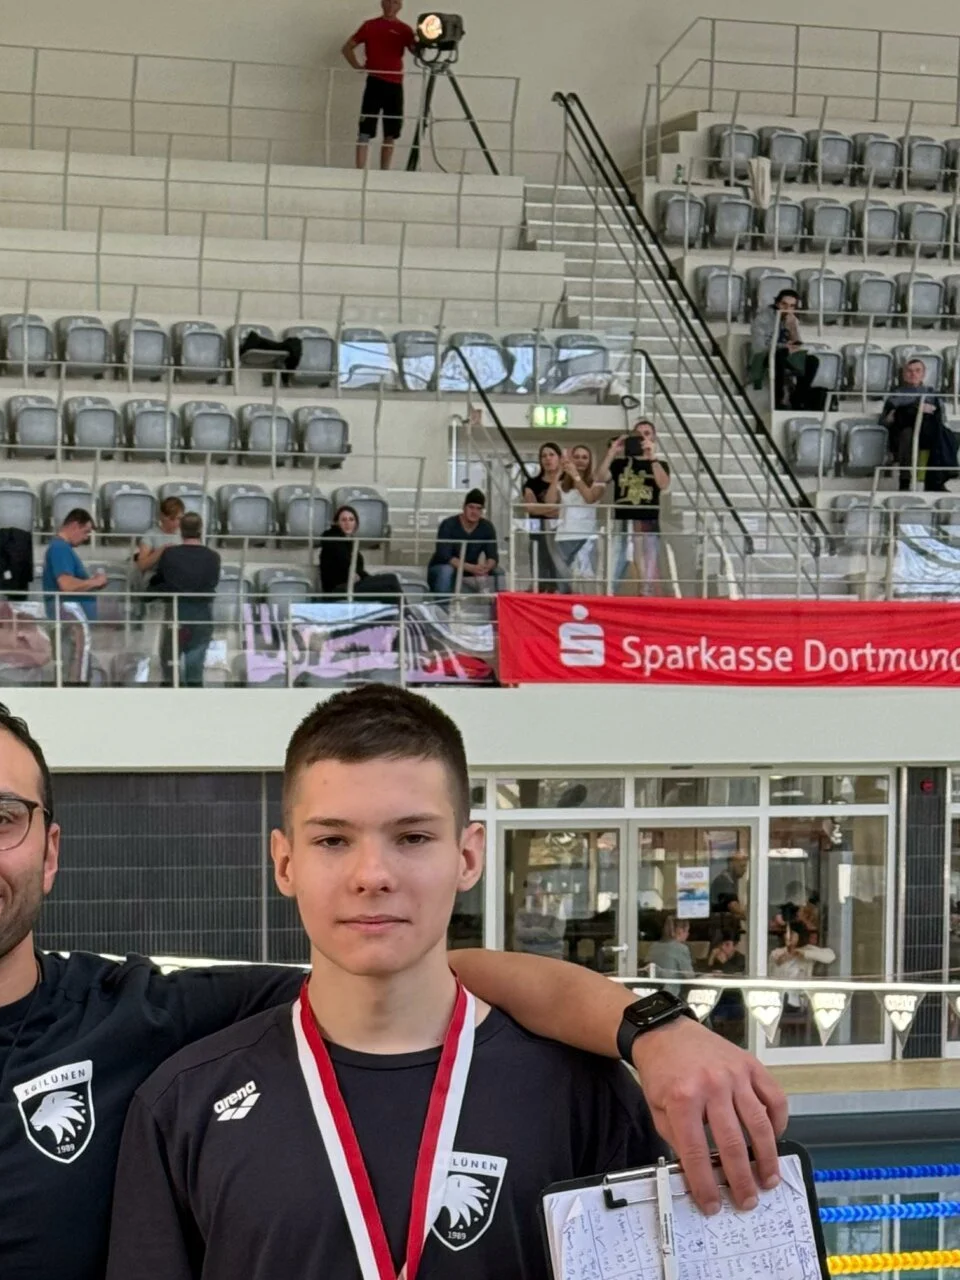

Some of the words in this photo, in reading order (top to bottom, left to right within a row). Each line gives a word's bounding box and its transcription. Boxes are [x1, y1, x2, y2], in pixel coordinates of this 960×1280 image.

[622, 636, 793, 677] Sparkasse
[43, 1068, 86, 1086] LÜNEN
[213, 1080, 257, 1114] arena
[452, 1157, 498, 1171] LÜNEN
